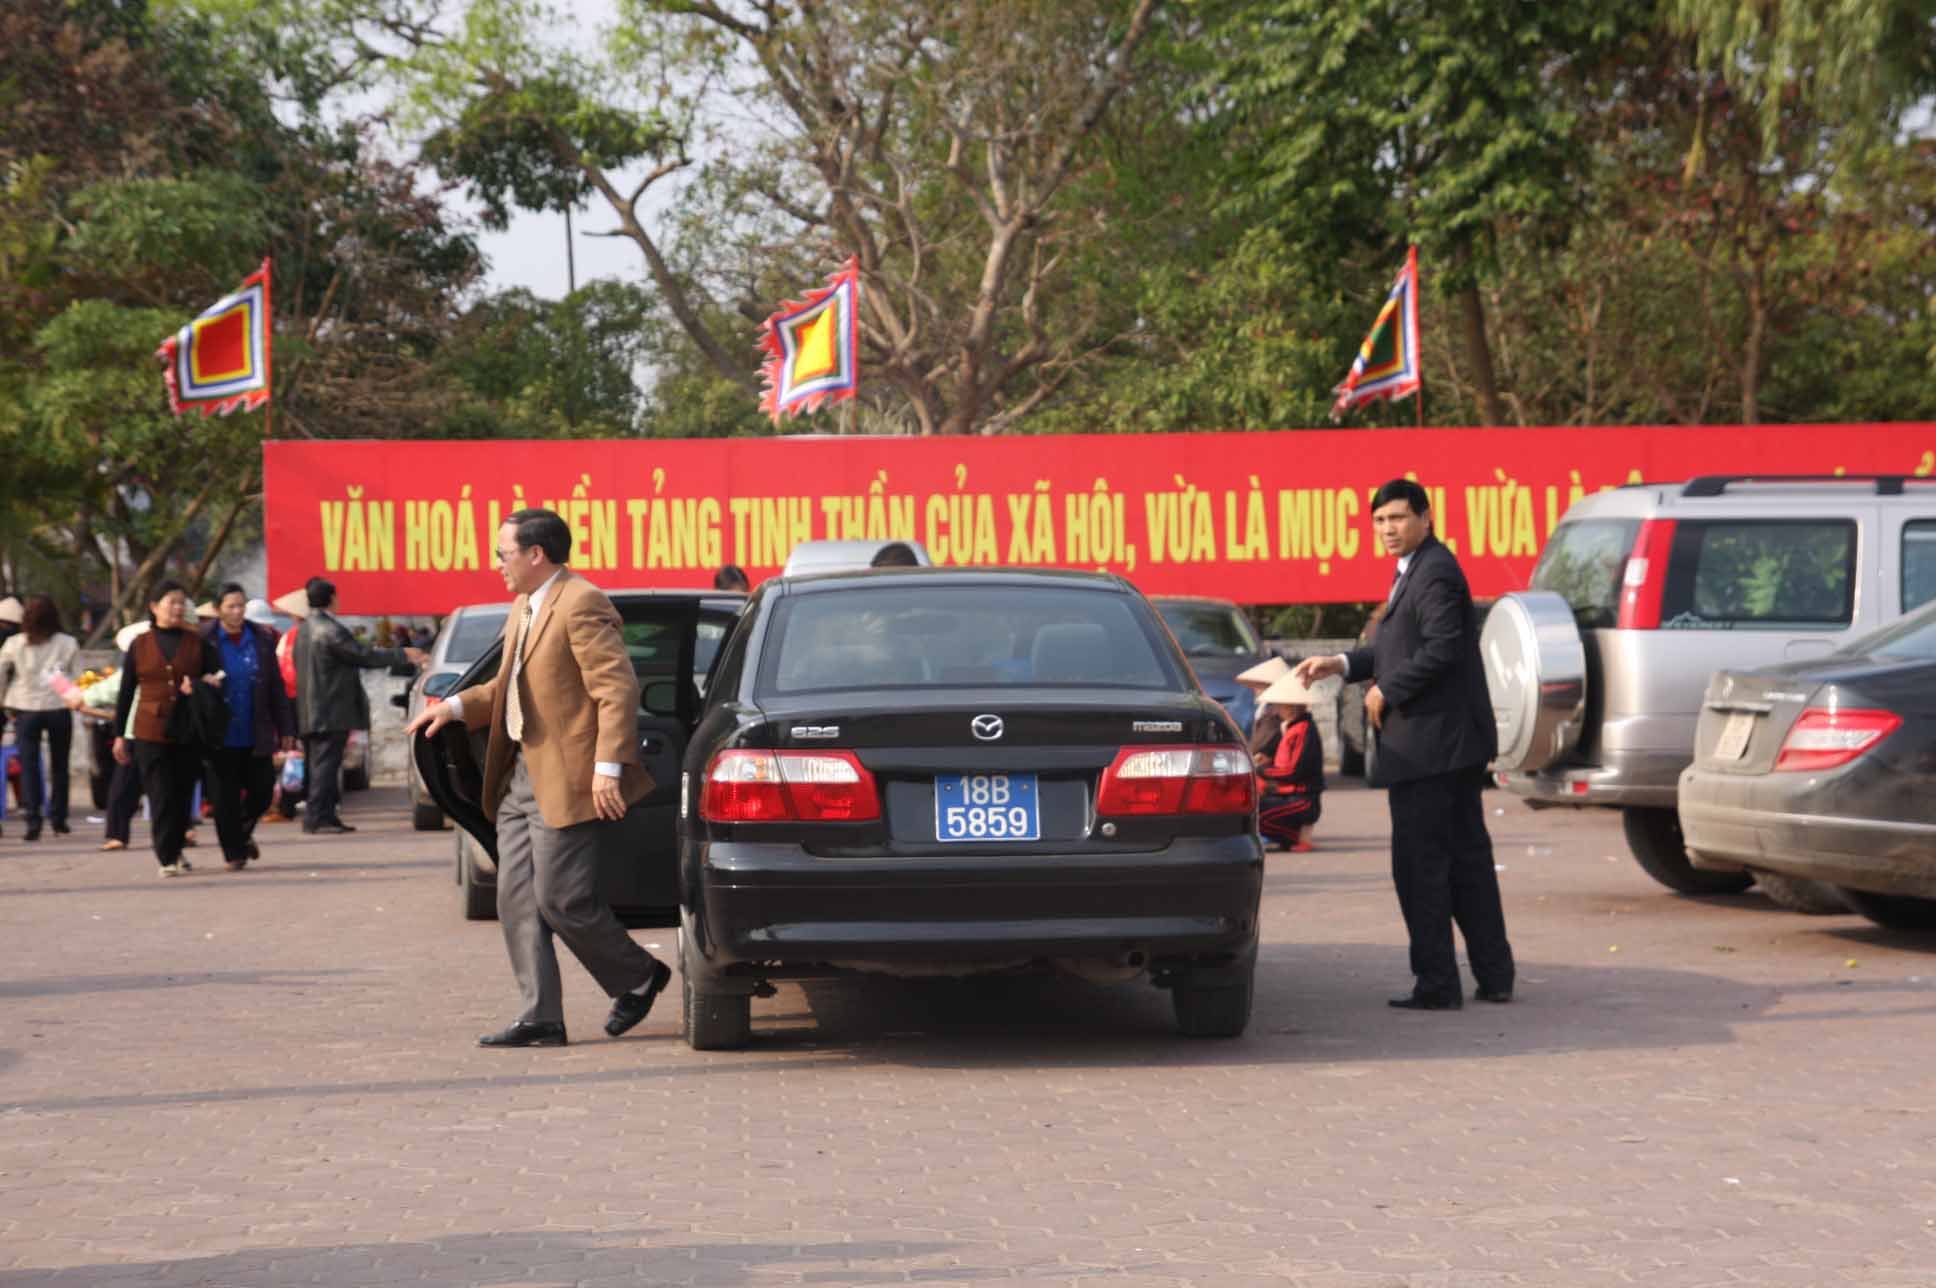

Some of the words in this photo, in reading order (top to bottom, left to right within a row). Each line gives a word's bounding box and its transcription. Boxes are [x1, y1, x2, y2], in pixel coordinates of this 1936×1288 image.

[320, 484, 395, 572] VĂN
[405, 484, 480, 572] HOÁ
[626, 467, 722, 570] TẢNG
[729, 496, 812, 569] TINH
[820, 469, 916, 543] THẦN
[925, 463, 999, 567] CỦA
[1007, 480, 1057, 564] XÃ
[1064, 478, 1137, 574] HỘI,
[1144, 474, 1218, 564] VỪA
[1225, 475, 1270, 561] LÀ
[1278, 487, 1361, 575] MỤC
[1464, 468, 1539, 557] VỪA
[960, 775, 1010, 805] 18B
[946, 806, 1028, 837] 5859
